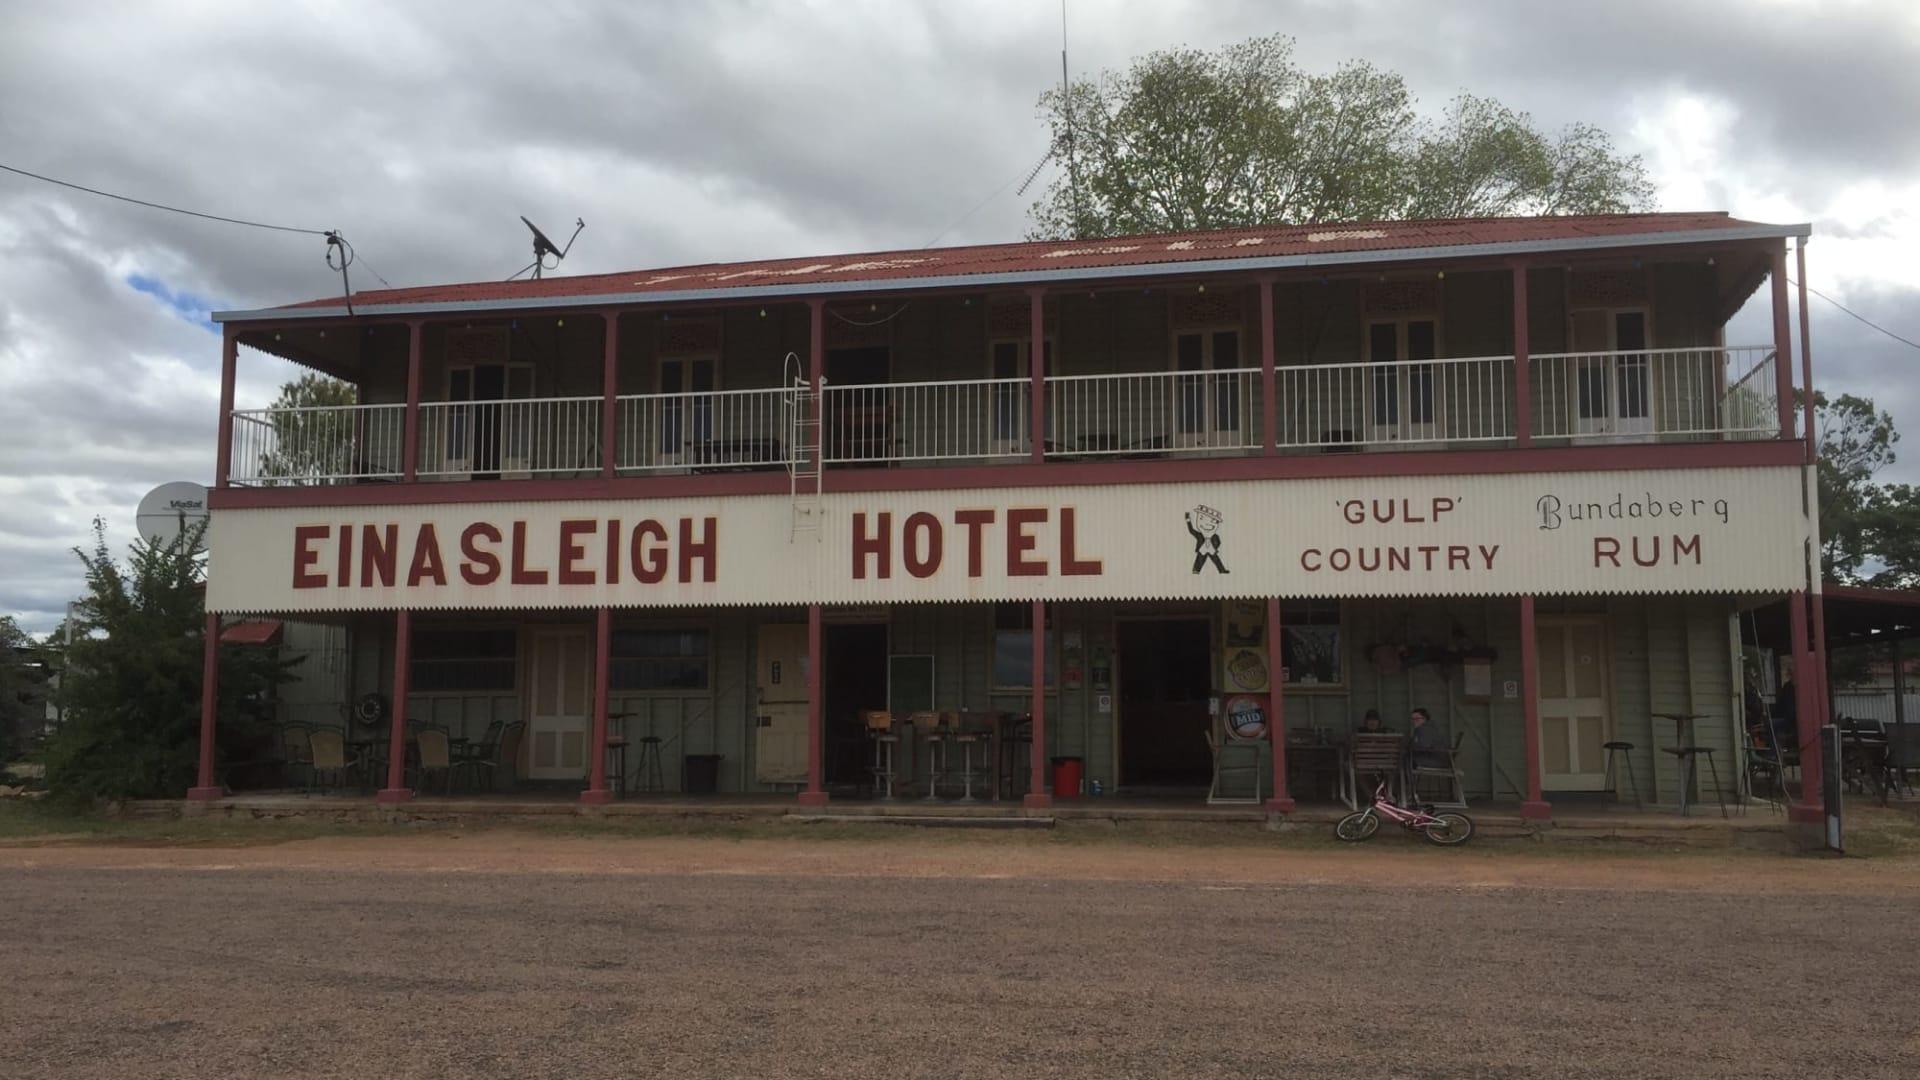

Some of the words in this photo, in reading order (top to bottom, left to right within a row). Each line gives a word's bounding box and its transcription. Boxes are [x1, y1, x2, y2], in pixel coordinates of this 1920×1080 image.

[1536, 492, 1729, 530] Bundaberg
[292, 516, 717, 589] EINASLEIGH
[852, 507, 1103, 579] HOTEL
[1301, 544, 1500, 572] COUNTRY
[1593, 534, 1702, 568] RUM
[1236, 712, 1261, 726] MID
